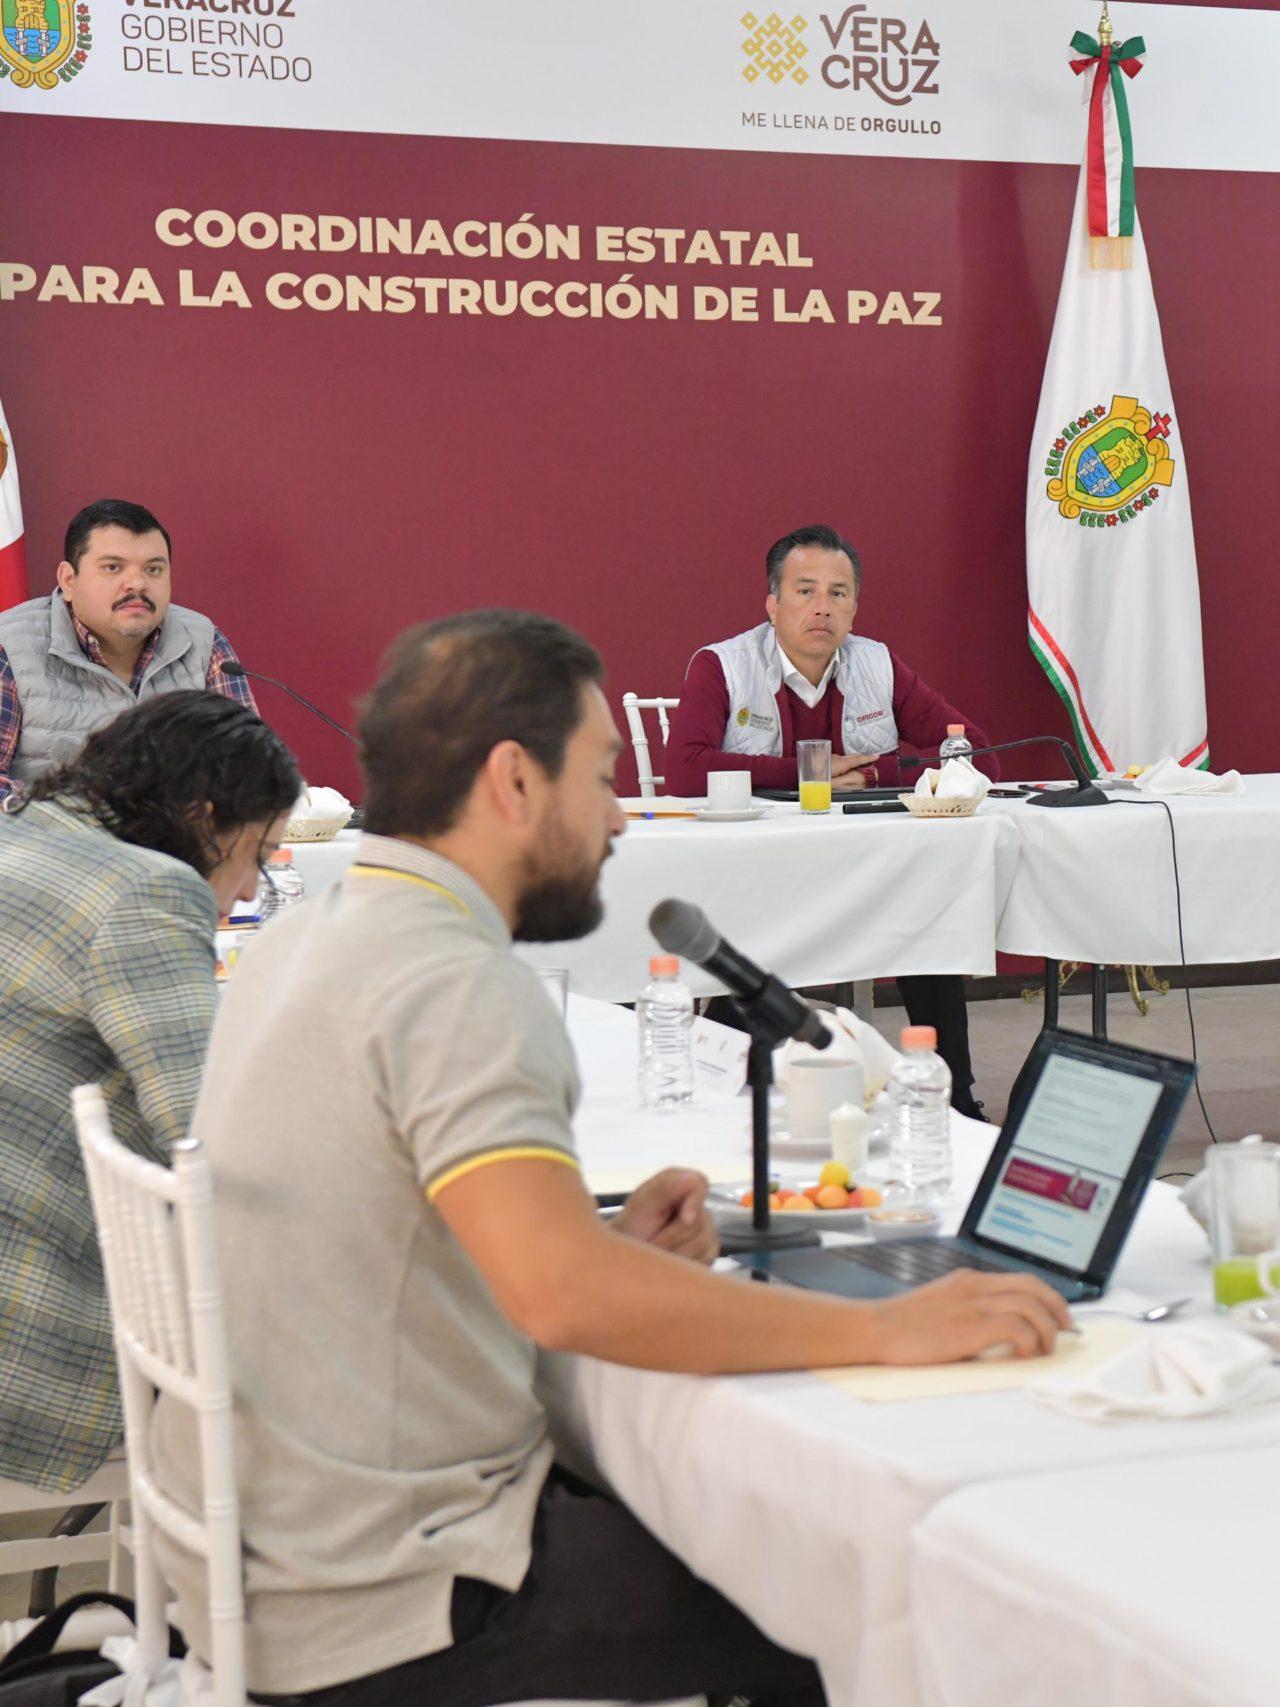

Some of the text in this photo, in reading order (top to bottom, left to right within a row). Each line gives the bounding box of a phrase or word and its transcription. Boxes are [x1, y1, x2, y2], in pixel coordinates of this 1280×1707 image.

[121, 13, 284, 49] GOBIERNO
[125, 0, 296, 18] CRUZ
[819, 3, 941, 57] VERA
[123, 46, 312, 83] DEL ESTADO
[820, 54, 941, 107] CRUZ
[741, 111, 942, 135] ME LLENA DE ORGULLO
[155, 208, 815, 268] COORDINACIÓN ESTATAL
[0, 262, 944, 326] PARA LA CONSTRUCCIÓN DE LA PAZ
